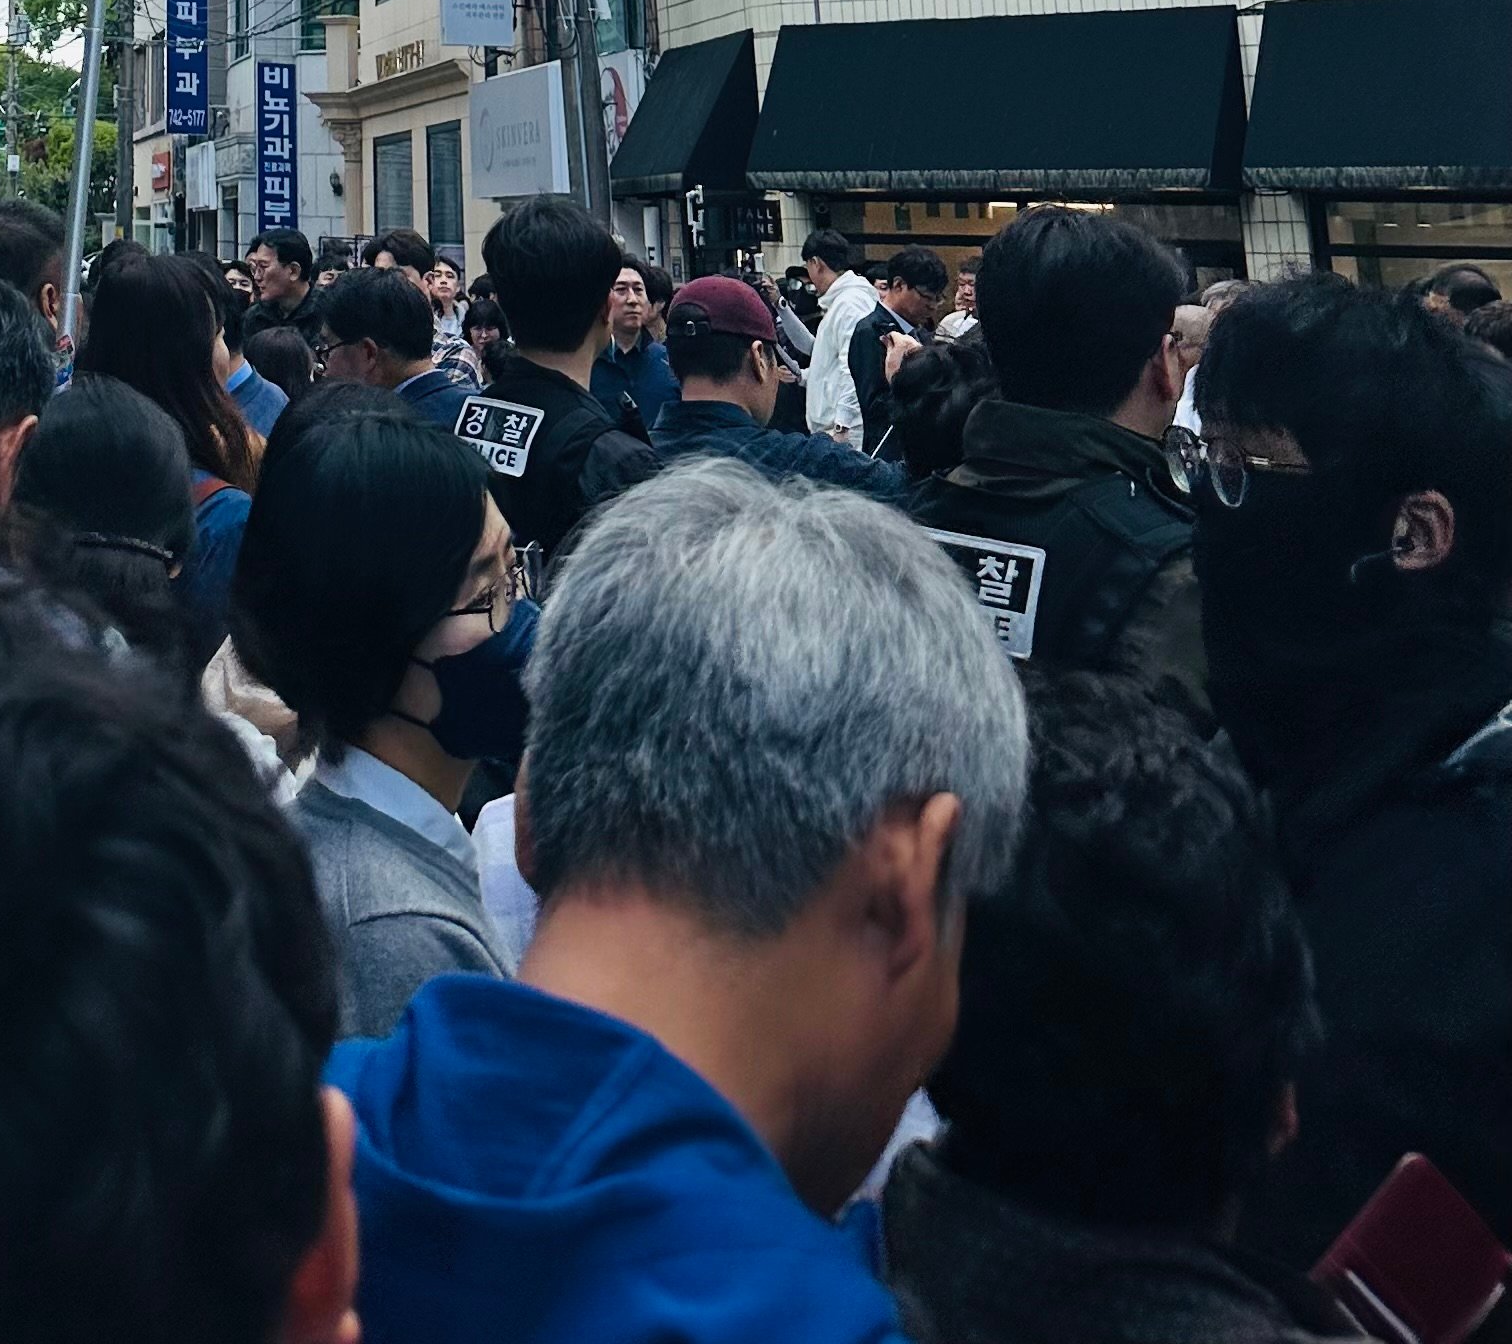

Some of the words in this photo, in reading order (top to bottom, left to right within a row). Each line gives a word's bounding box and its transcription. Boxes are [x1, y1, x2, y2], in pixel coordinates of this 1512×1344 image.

[168, 108, 206, 127] 742-5177
[263, 66, 293, 160] 비뇨기과
[263, 176, 291, 230] 피부
[465, 405, 529, 445] 경찰
